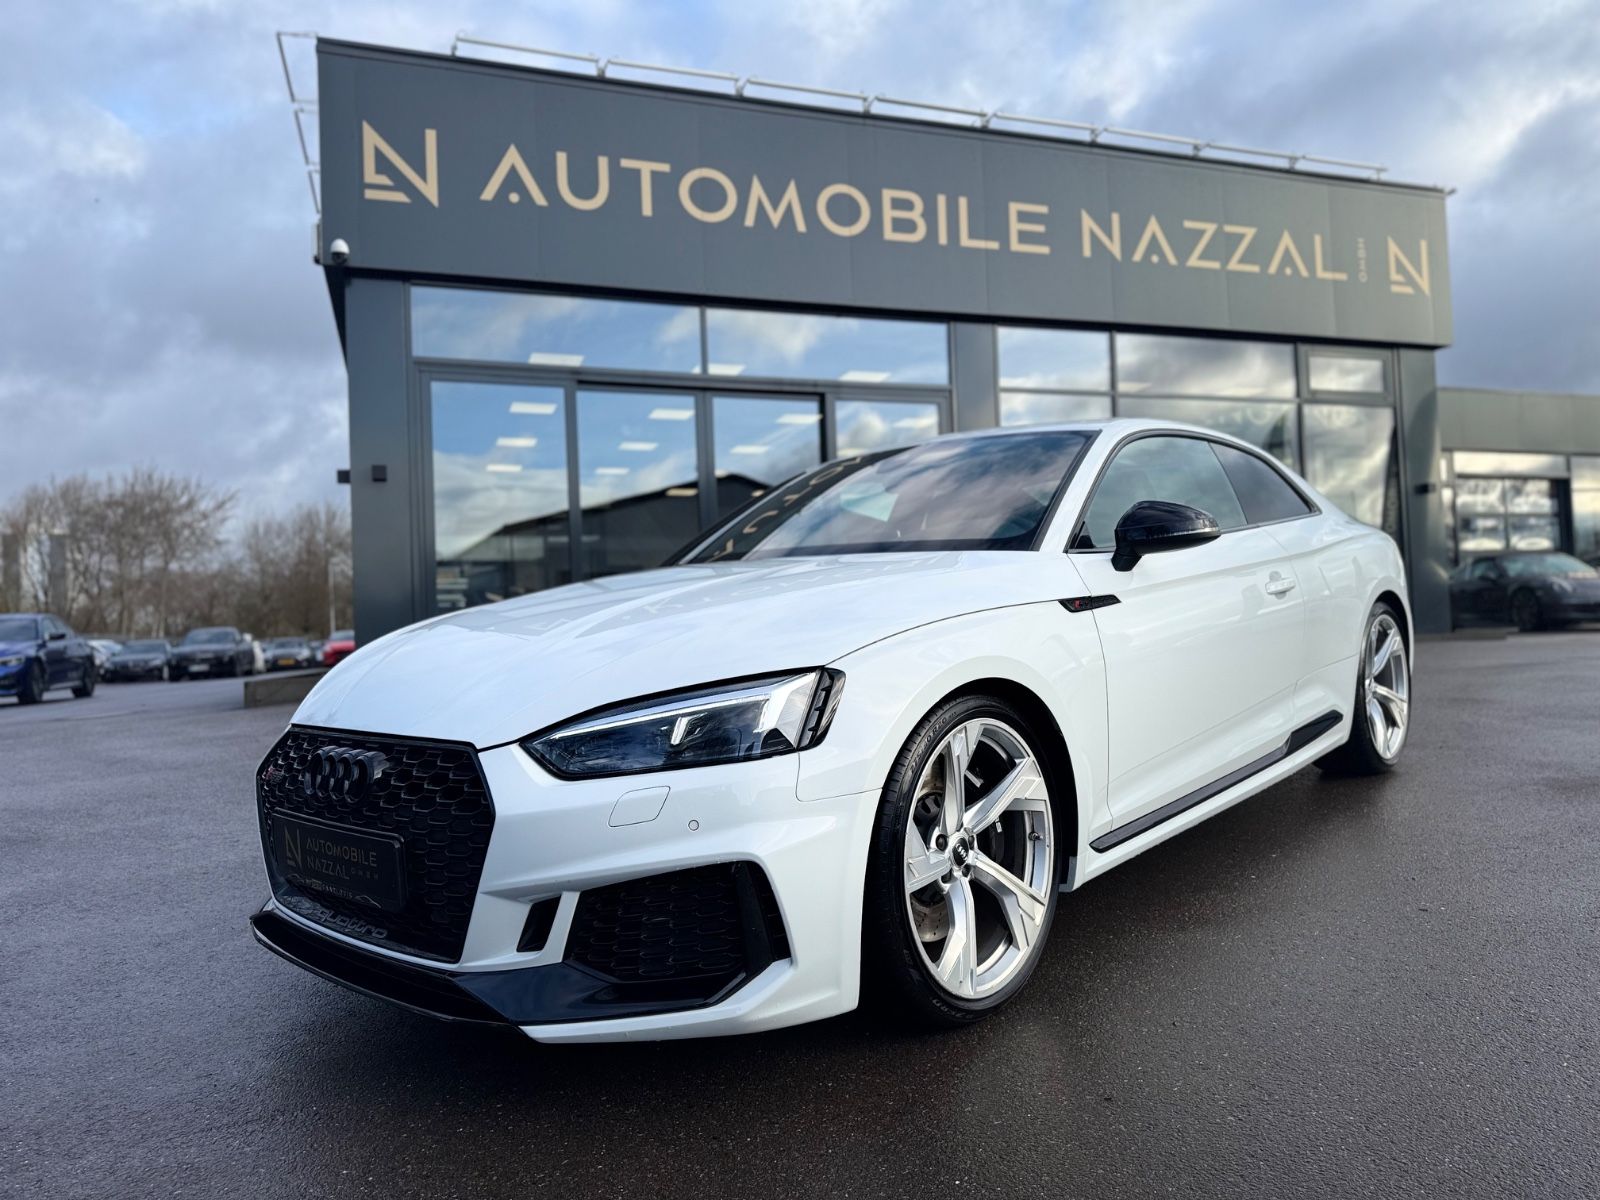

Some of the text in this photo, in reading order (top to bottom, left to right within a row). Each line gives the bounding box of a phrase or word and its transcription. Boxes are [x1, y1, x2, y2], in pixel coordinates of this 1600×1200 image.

[480, 143, 1349, 283] AUTOMOBILE NAZZAL
[306, 838, 377, 868] AUTOMOBILE
[306, 856, 350, 880] NAZZAL
[317, 909, 389, 939] quattro
